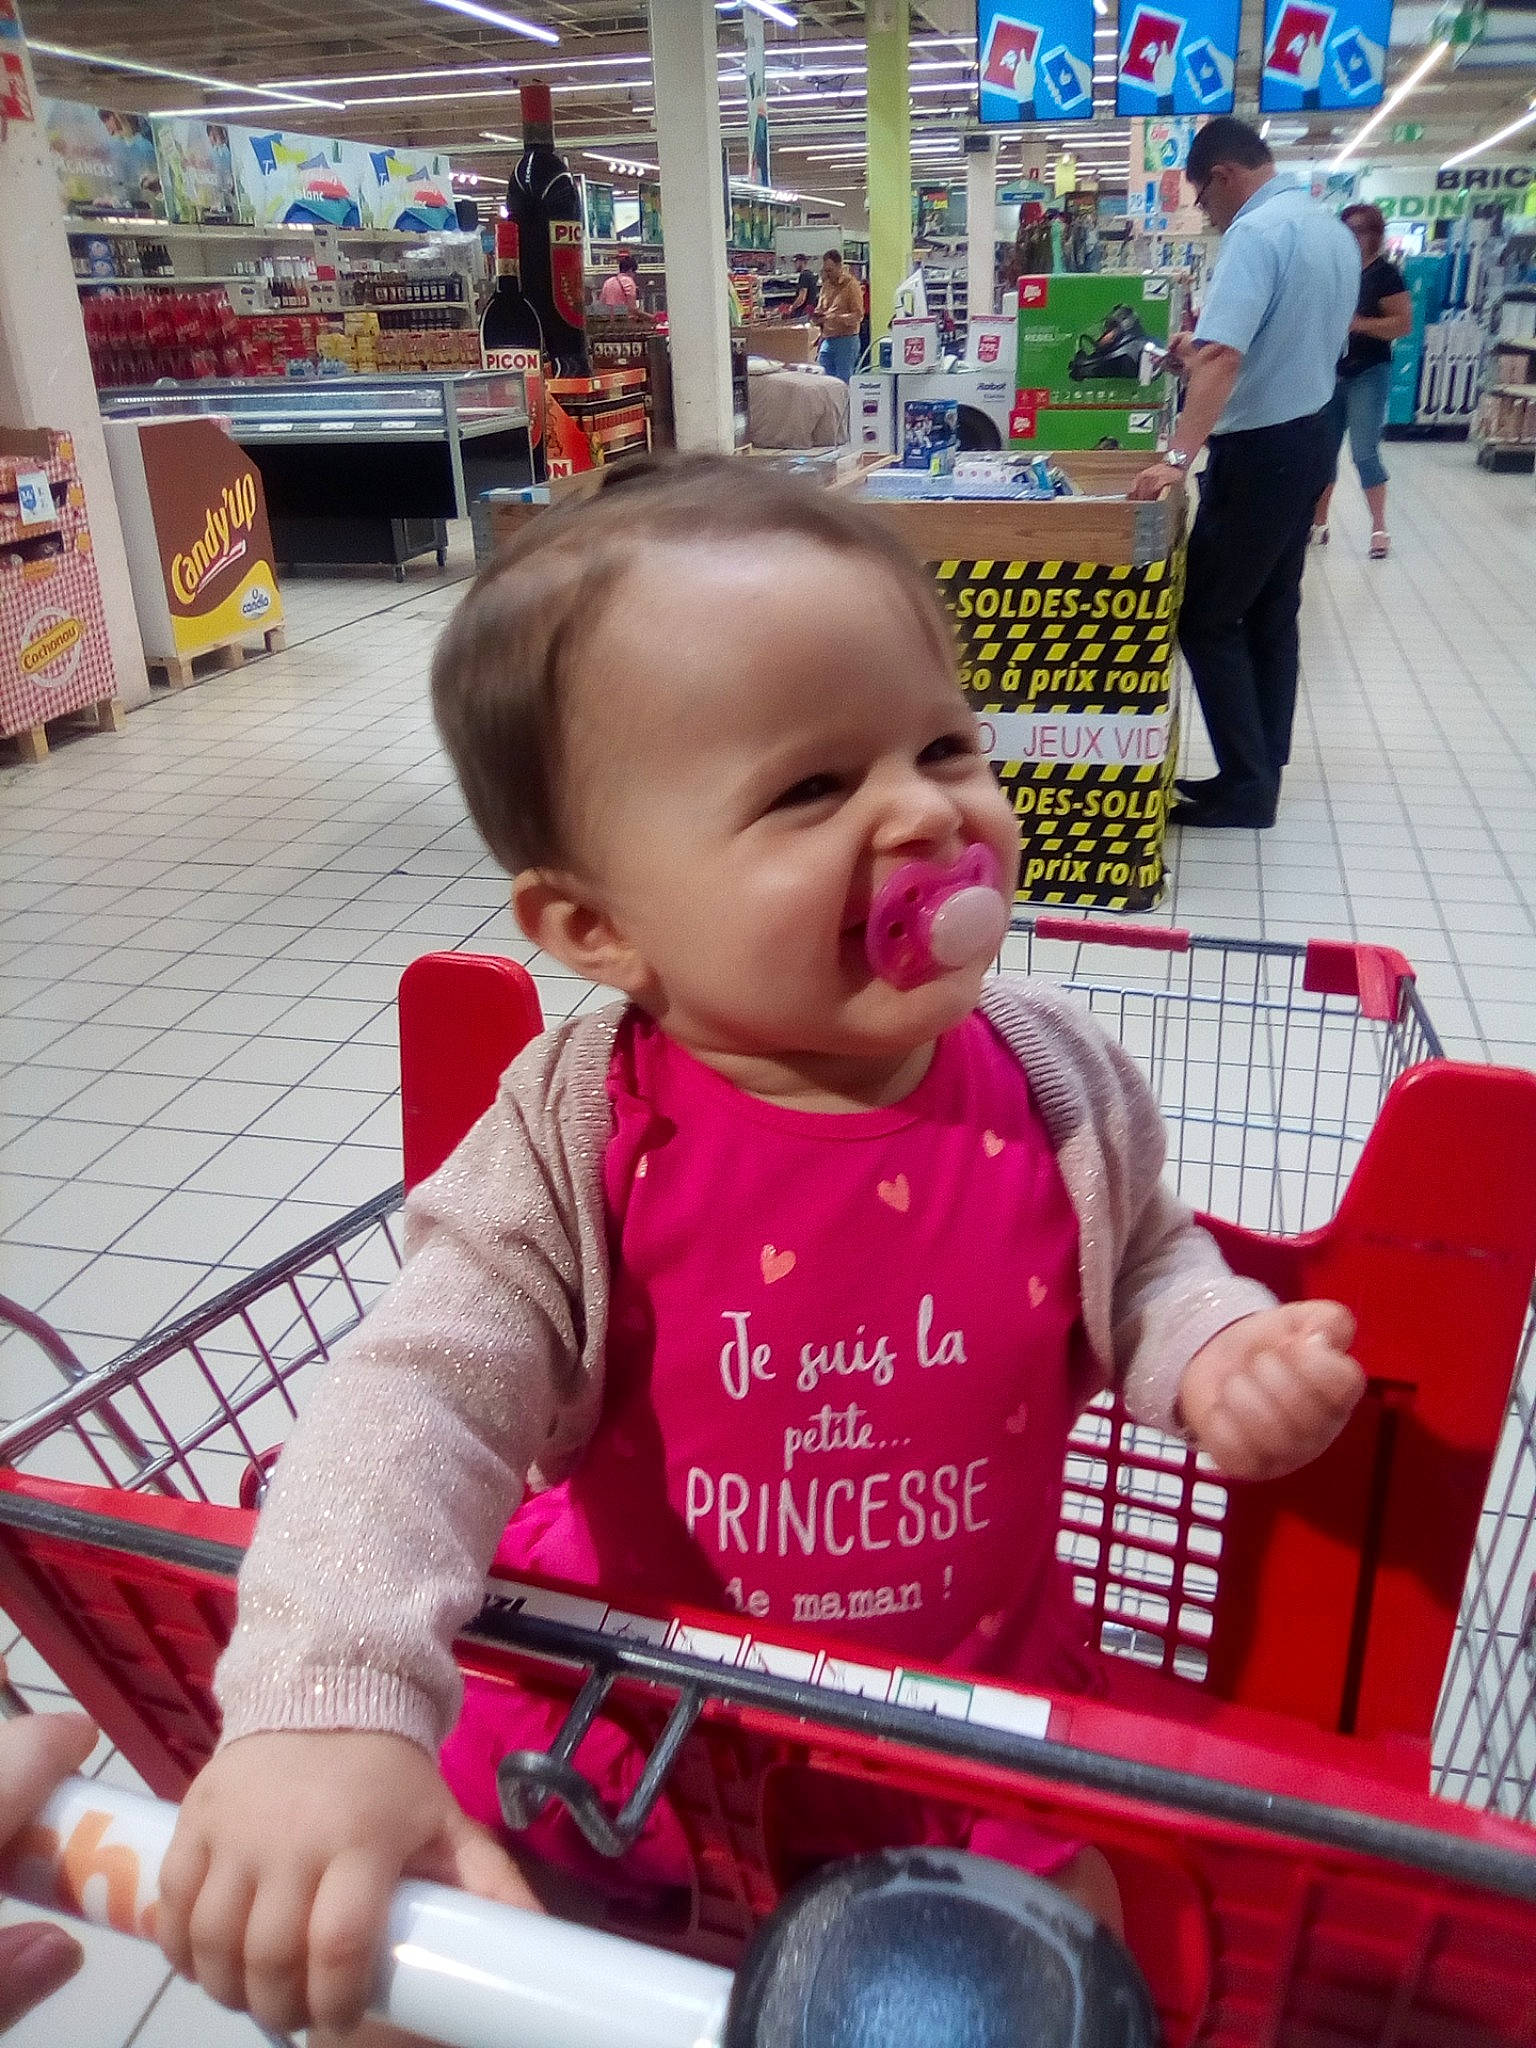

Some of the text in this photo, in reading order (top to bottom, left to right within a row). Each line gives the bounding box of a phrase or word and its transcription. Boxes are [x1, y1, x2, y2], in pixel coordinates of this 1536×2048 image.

[487, 354, 538, 370] PICON
[24, 626, 77, 669] Cochonou
[1001, 660, 1023, 692] à
[1027, 660, 1100, 701] prix
[1023, 726, 1105, 758] JEUX
[1023, 853, 1092, 888] prix
[719, 1293, 968, 1400] Je suis la
[685, 1456, 990, 1556] PRINCESSE
[792, 1581, 923, 1622] maman
